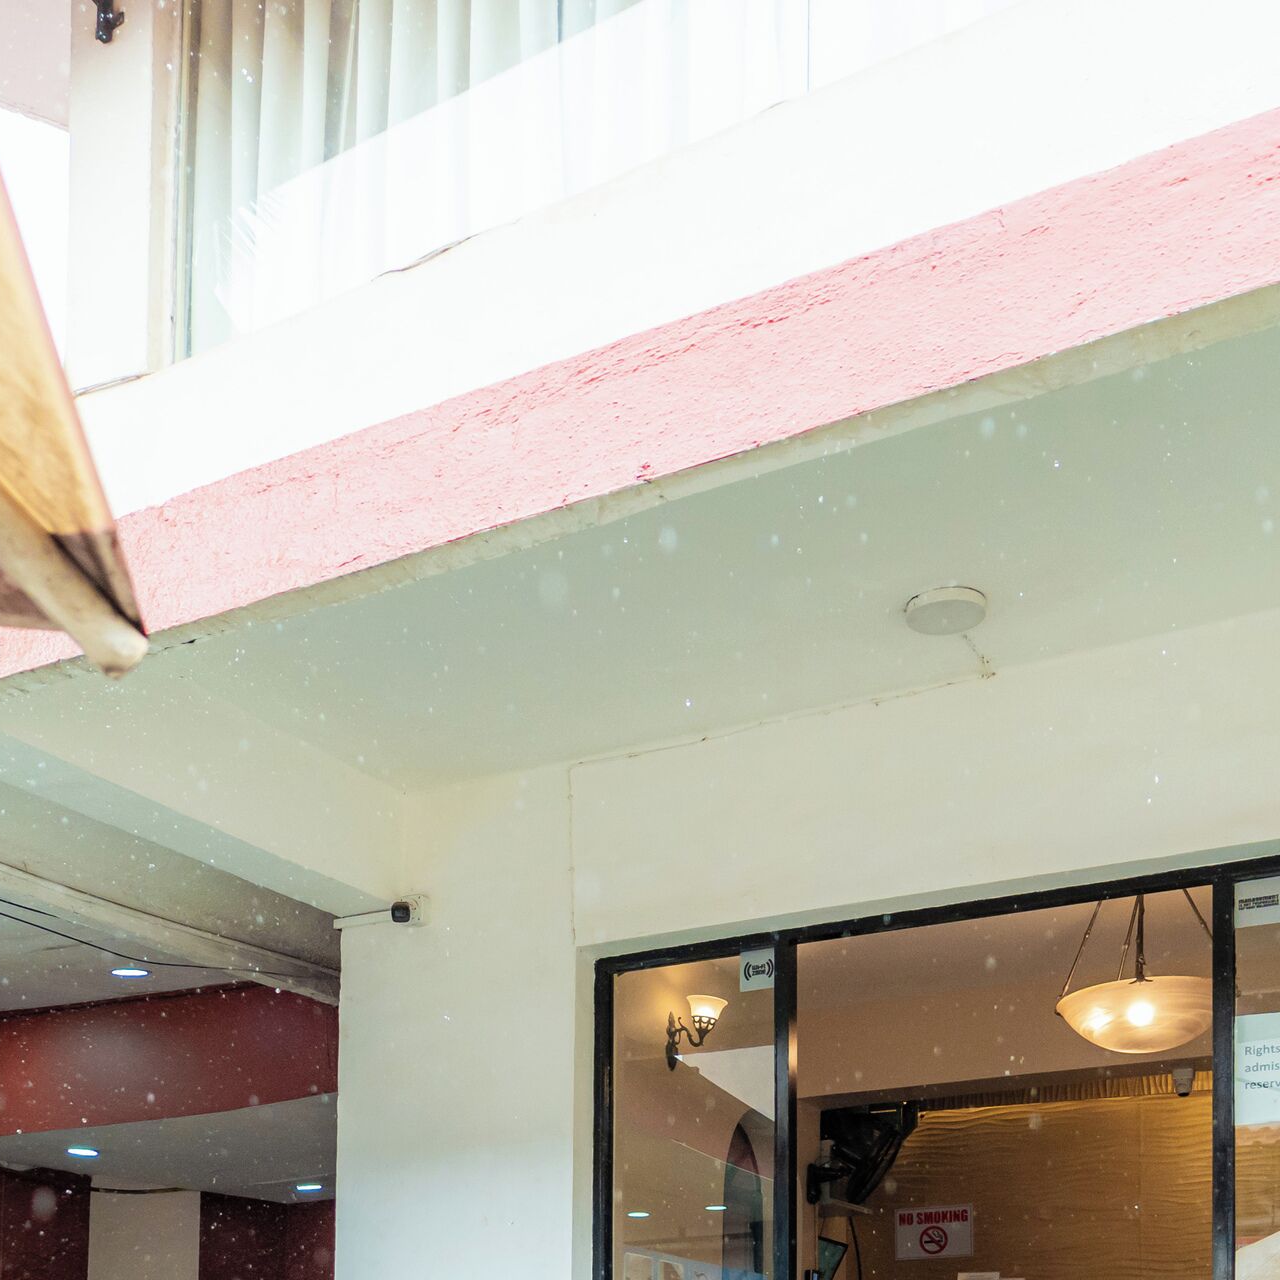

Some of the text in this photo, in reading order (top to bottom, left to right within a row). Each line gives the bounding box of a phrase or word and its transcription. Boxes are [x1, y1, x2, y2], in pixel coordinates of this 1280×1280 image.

[1245, 1044, 1280, 1057] Rights
[899, 1209, 969, 1226] NO SMOKING
